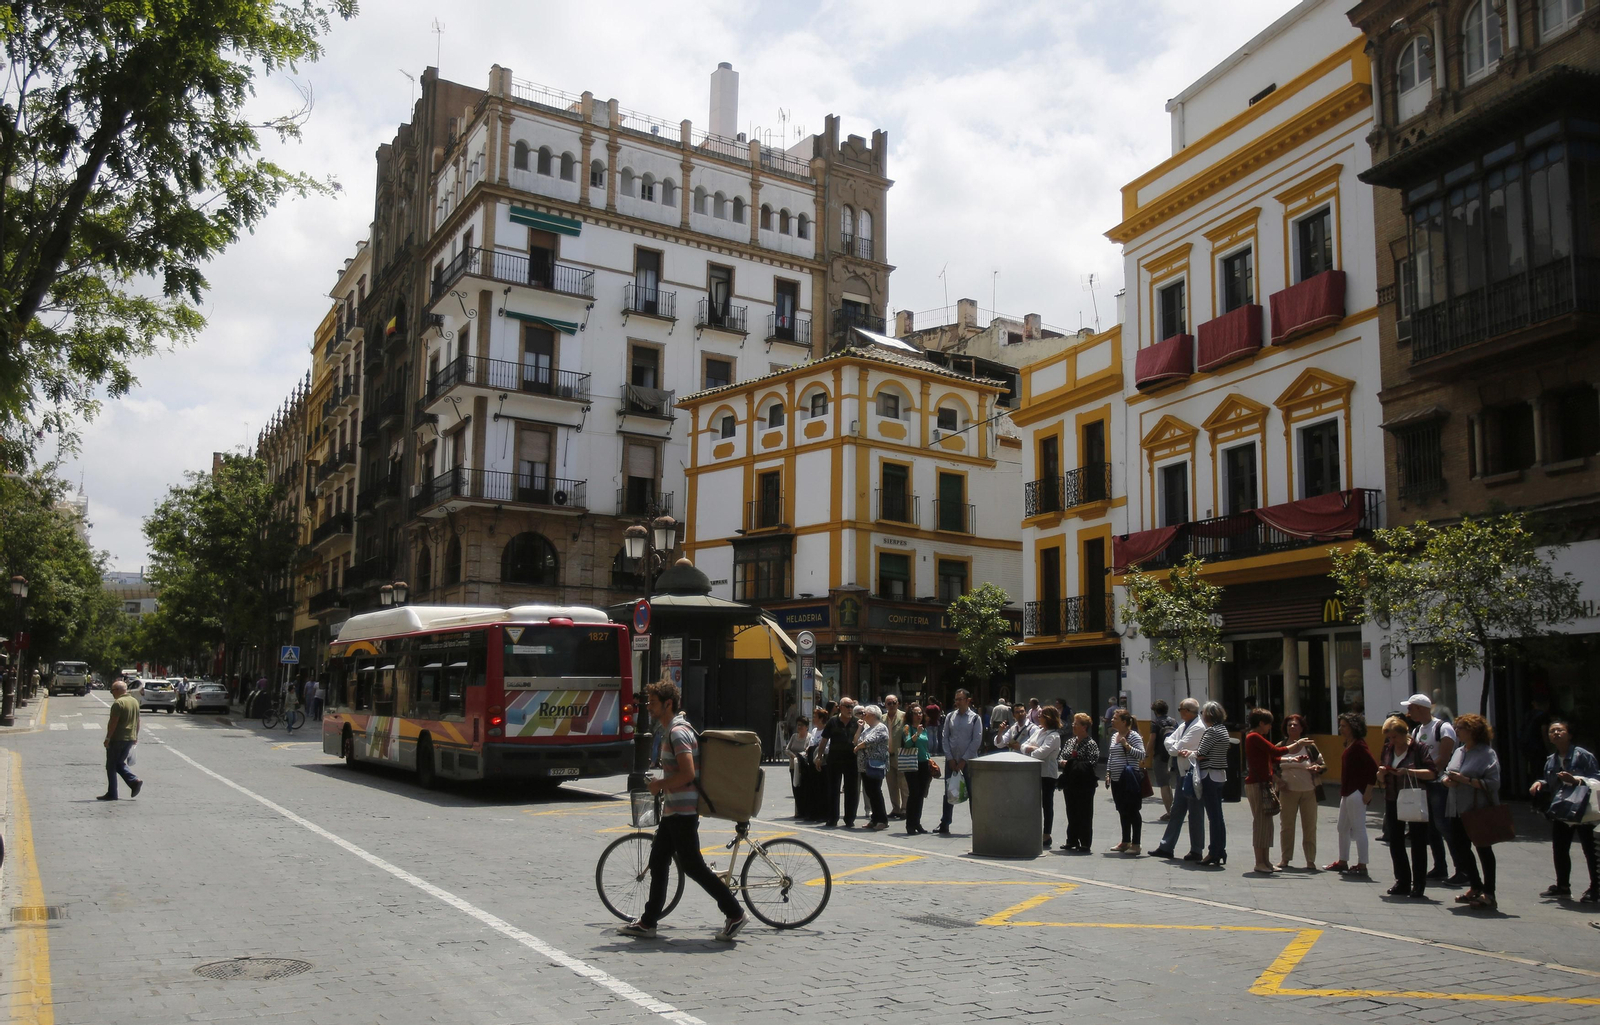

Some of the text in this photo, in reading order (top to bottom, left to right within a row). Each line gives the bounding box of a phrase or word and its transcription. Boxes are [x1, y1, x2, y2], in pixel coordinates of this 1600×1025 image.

[883, 537, 908, 547] SIERPES
[785, 614, 823, 624] HELADERIA
[888, 614, 929, 625] CONFITERIA
[588, 632, 610, 641] 1827
[539, 702, 590, 717] Renova
